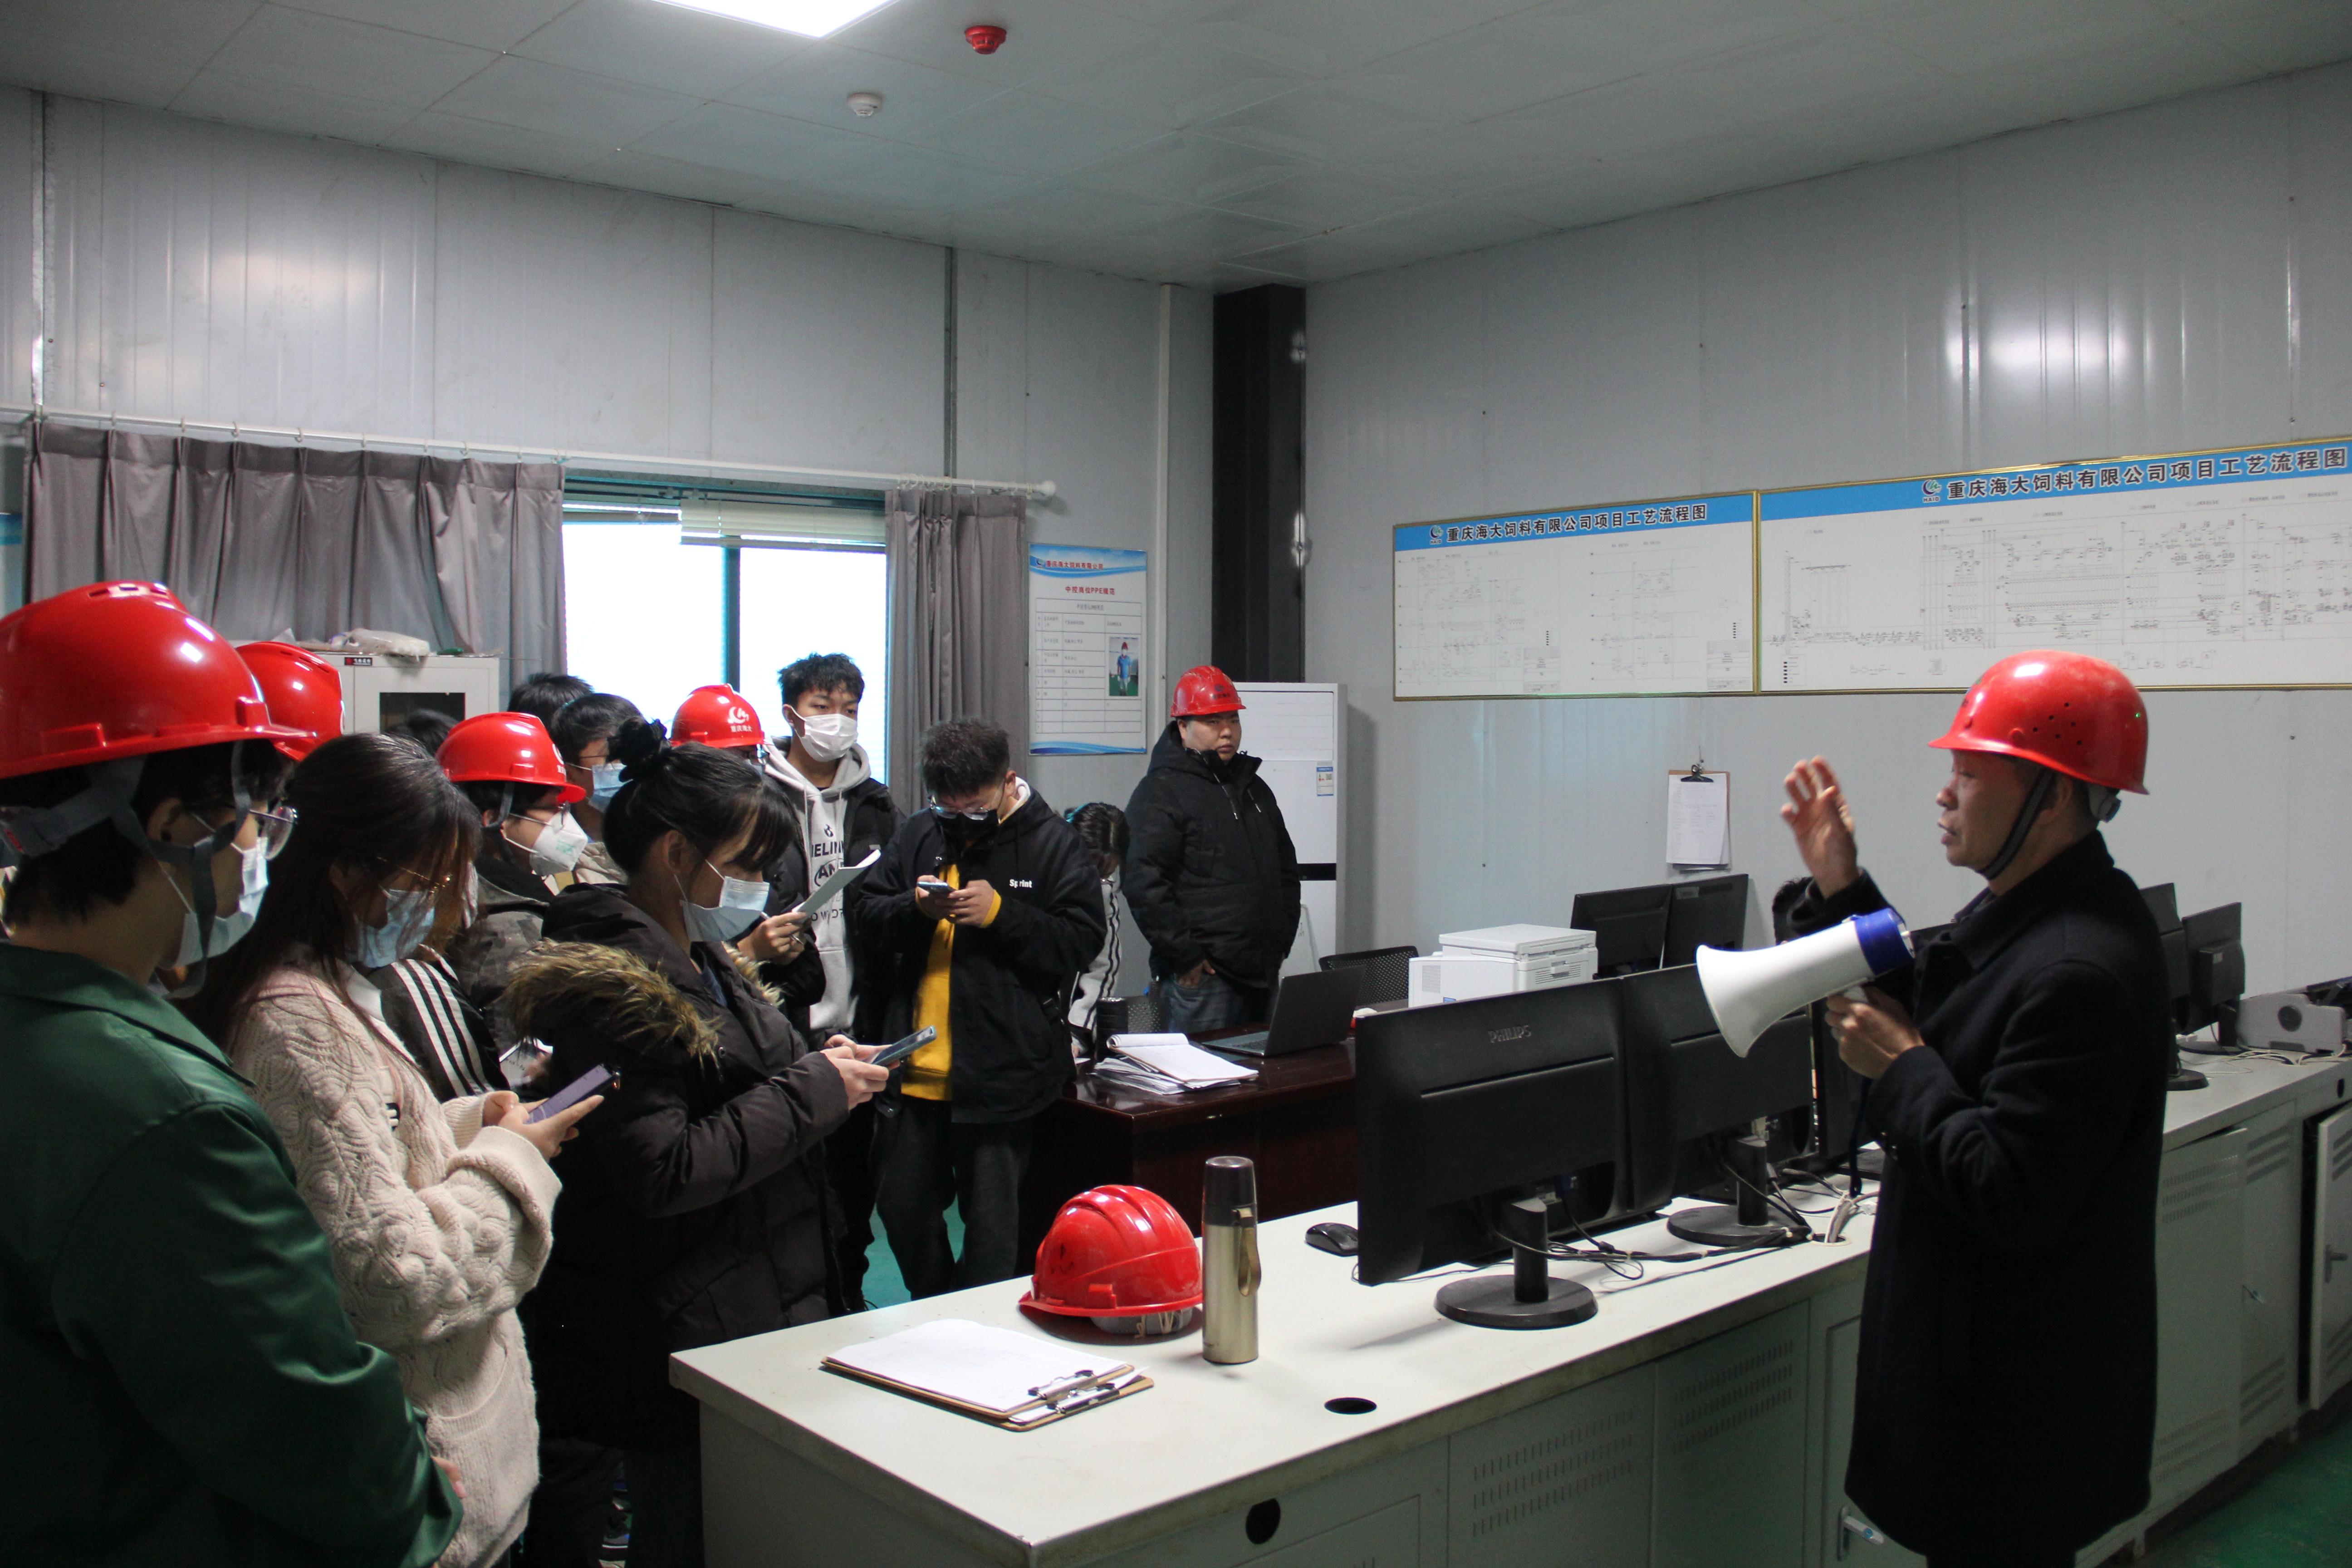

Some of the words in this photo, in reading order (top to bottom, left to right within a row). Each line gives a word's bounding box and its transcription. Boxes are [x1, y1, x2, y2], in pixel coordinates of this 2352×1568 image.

[1947, 447, 2347, 500] 重庆海大饲料有限公司项目工艺流程图
[1447, 504, 1707, 542] 重庆海大饲料有限公司项目工艺流程图
[1009, 879, 1033, 888] Sprint
[1488, 1025, 1532, 1043] PHILIPS
